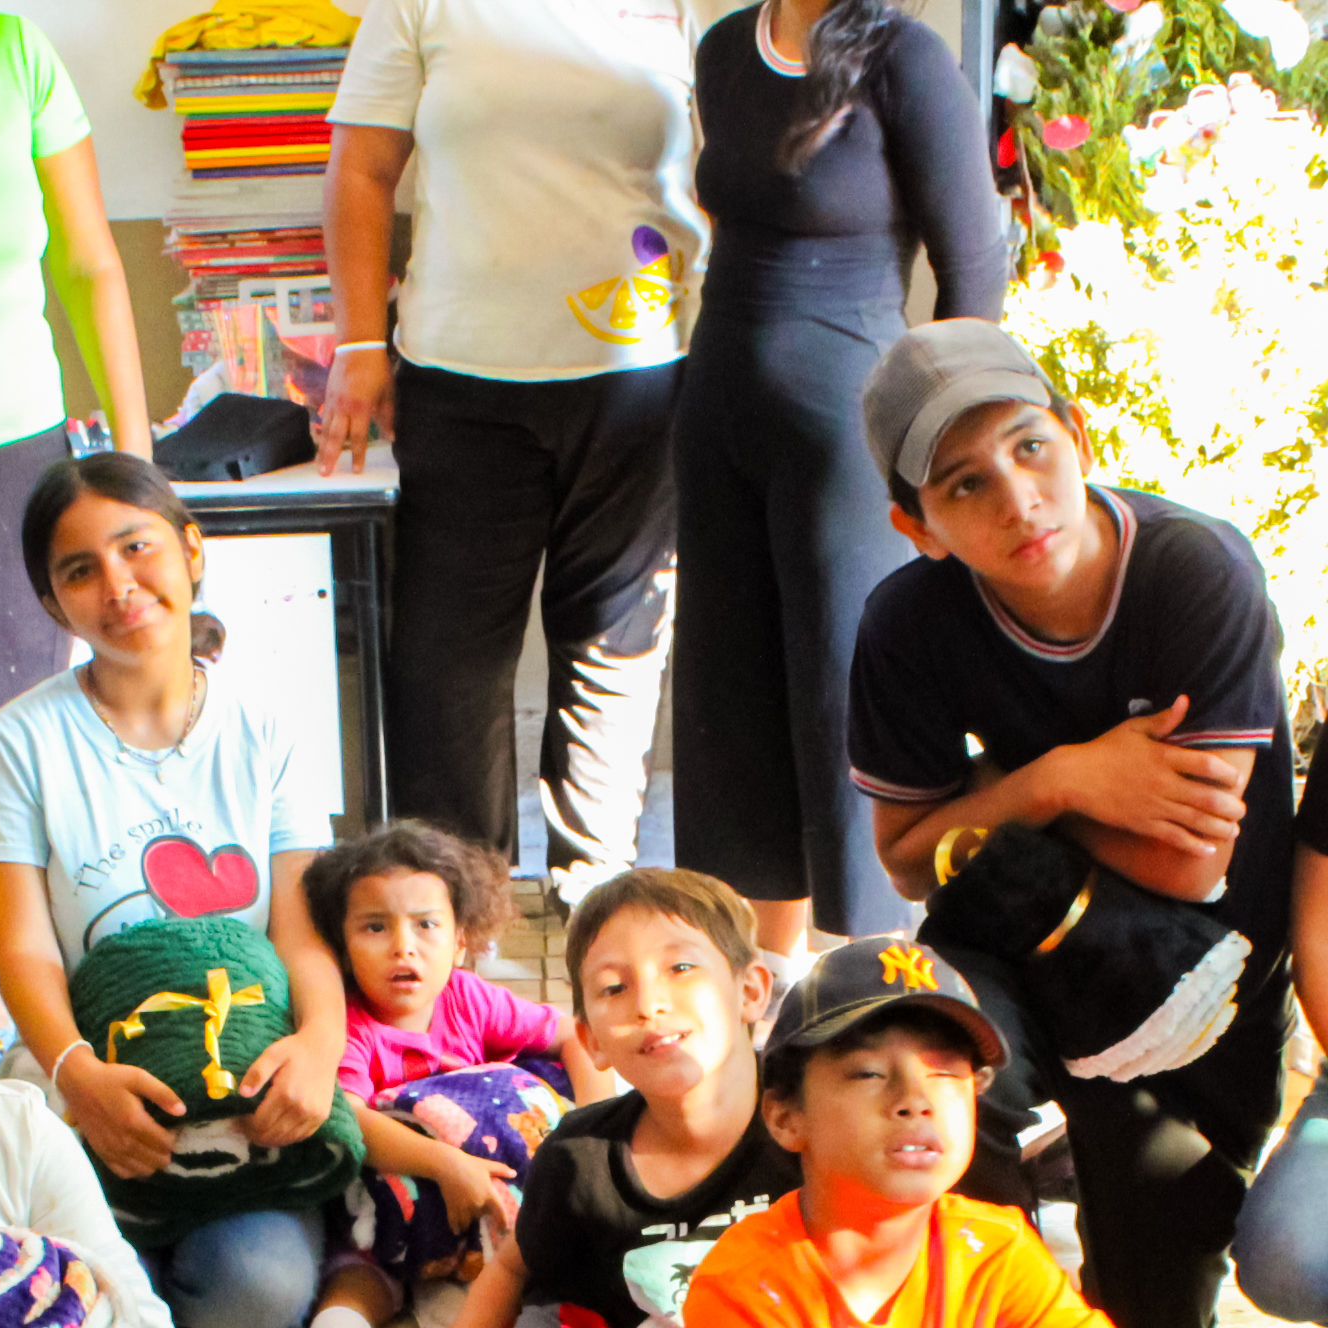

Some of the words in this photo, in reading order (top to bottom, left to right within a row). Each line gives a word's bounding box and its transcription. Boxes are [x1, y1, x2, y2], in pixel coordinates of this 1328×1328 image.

[73, 843, 127, 897] The
[127, 808, 203, 845] smile
[878, 944, 940, 991] NY
